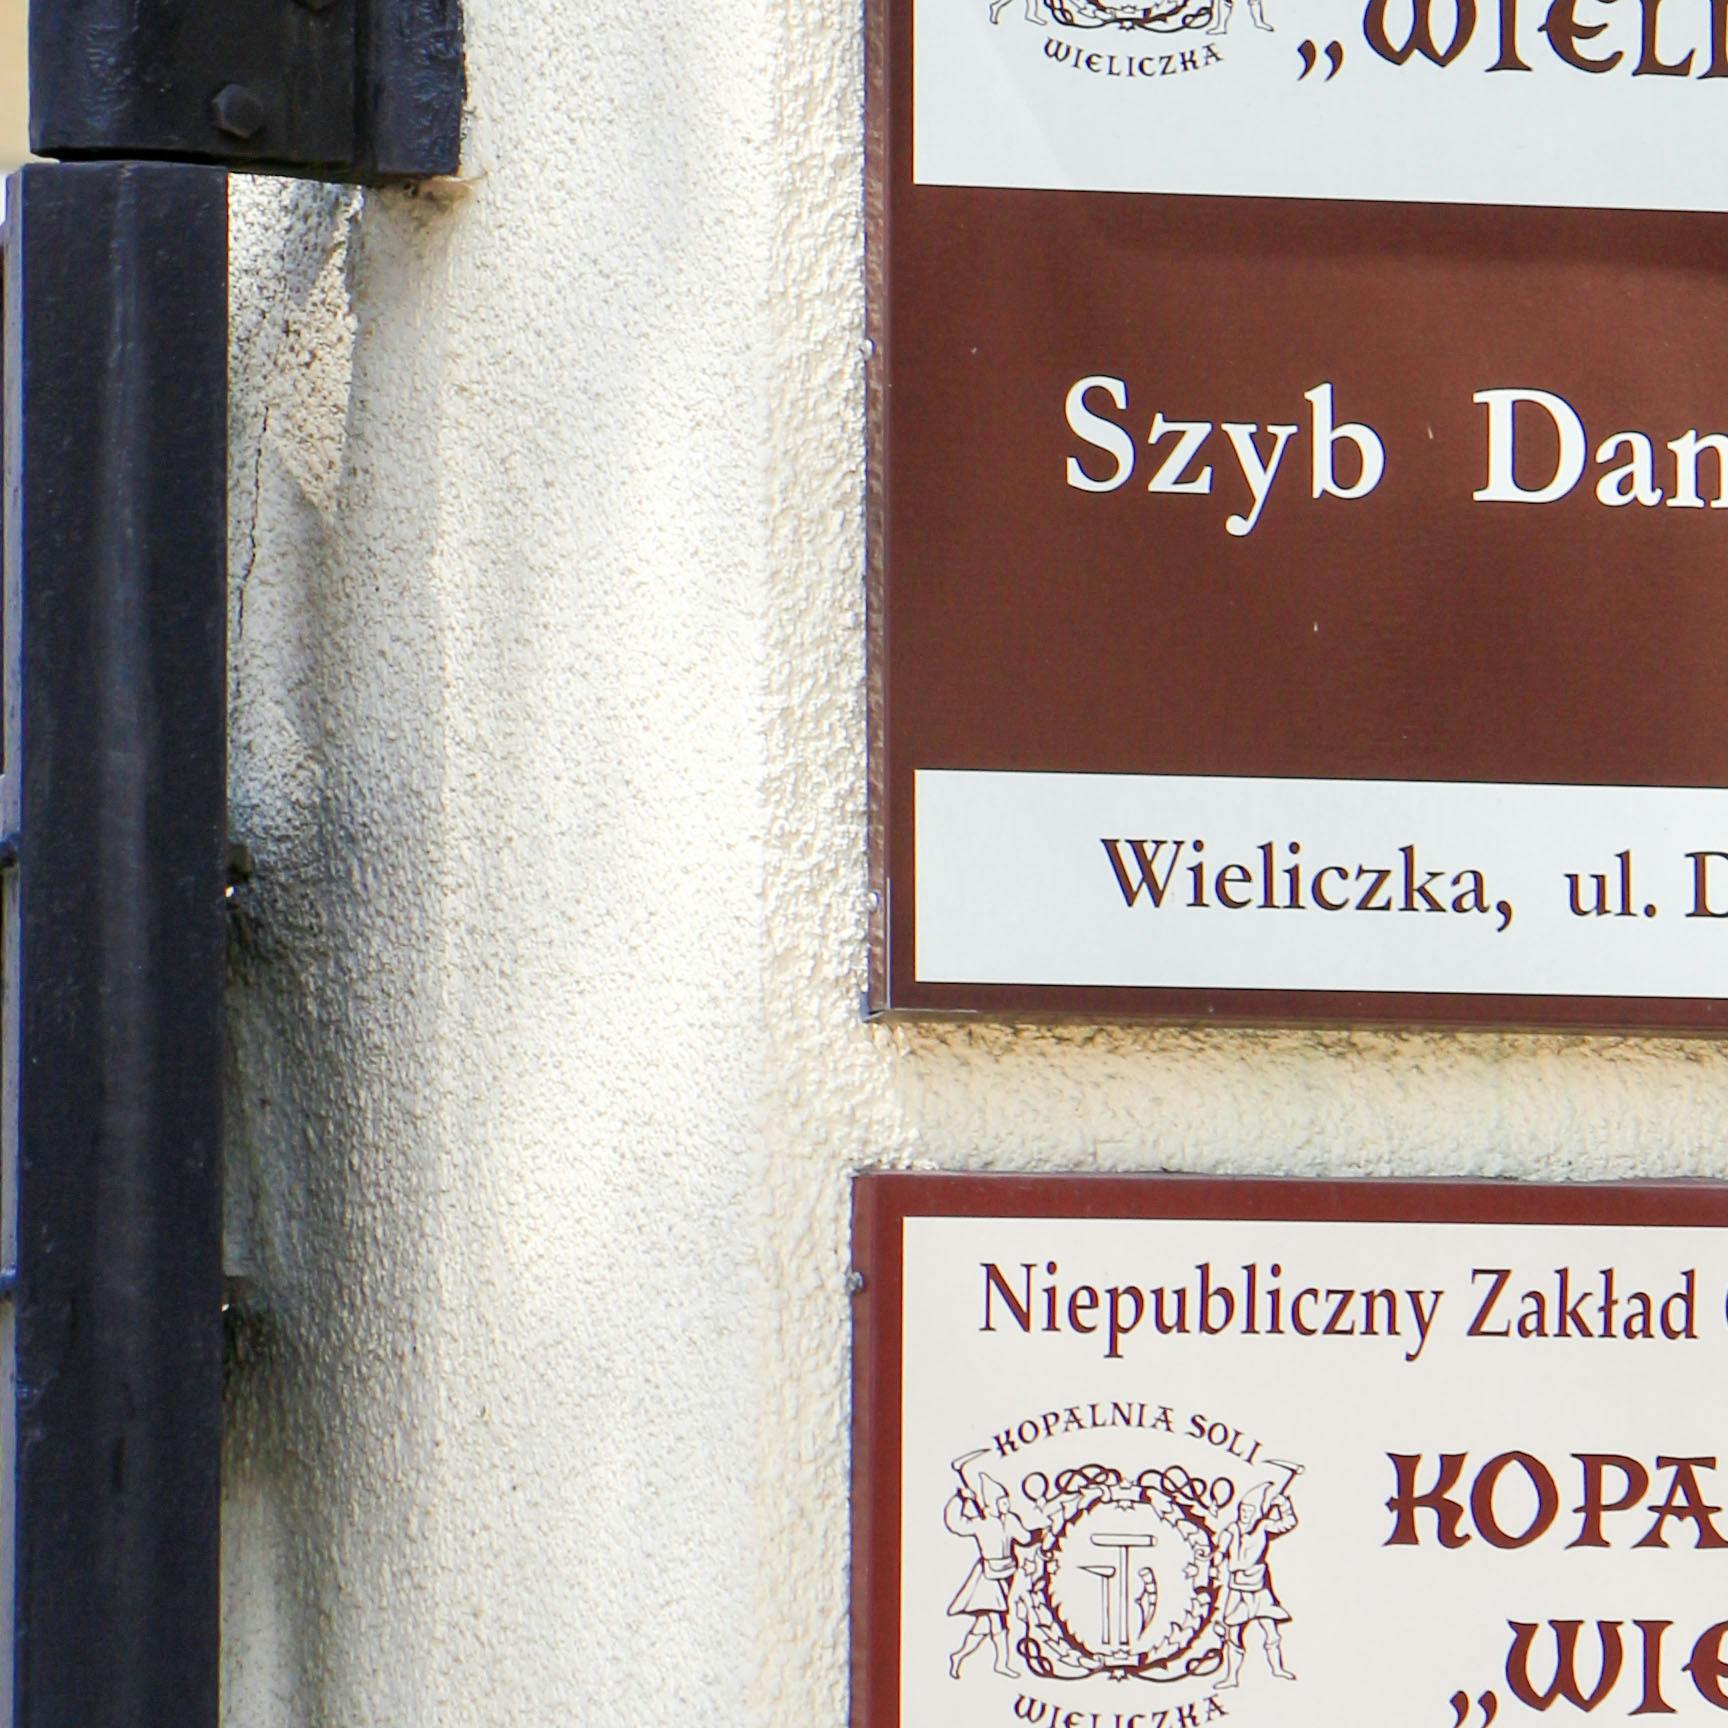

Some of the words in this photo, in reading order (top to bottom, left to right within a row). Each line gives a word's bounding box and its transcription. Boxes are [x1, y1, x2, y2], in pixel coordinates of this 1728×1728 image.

[1044, 37, 1223, 77] WIELICZKA
[1066, 376, 1383, 535] Szyb
[1100, 839, 1512, 932] Wieliczka,
[1564, 850, 1656, 918] ul.
[979, 1261, 1444, 1362] Niepubliczny
[1467, 1267, 1698, 1340] Zakład
[993, 1402, 1174, 1457] KOPALNIA
[1185, 1414, 1262, 1465] SOLI
